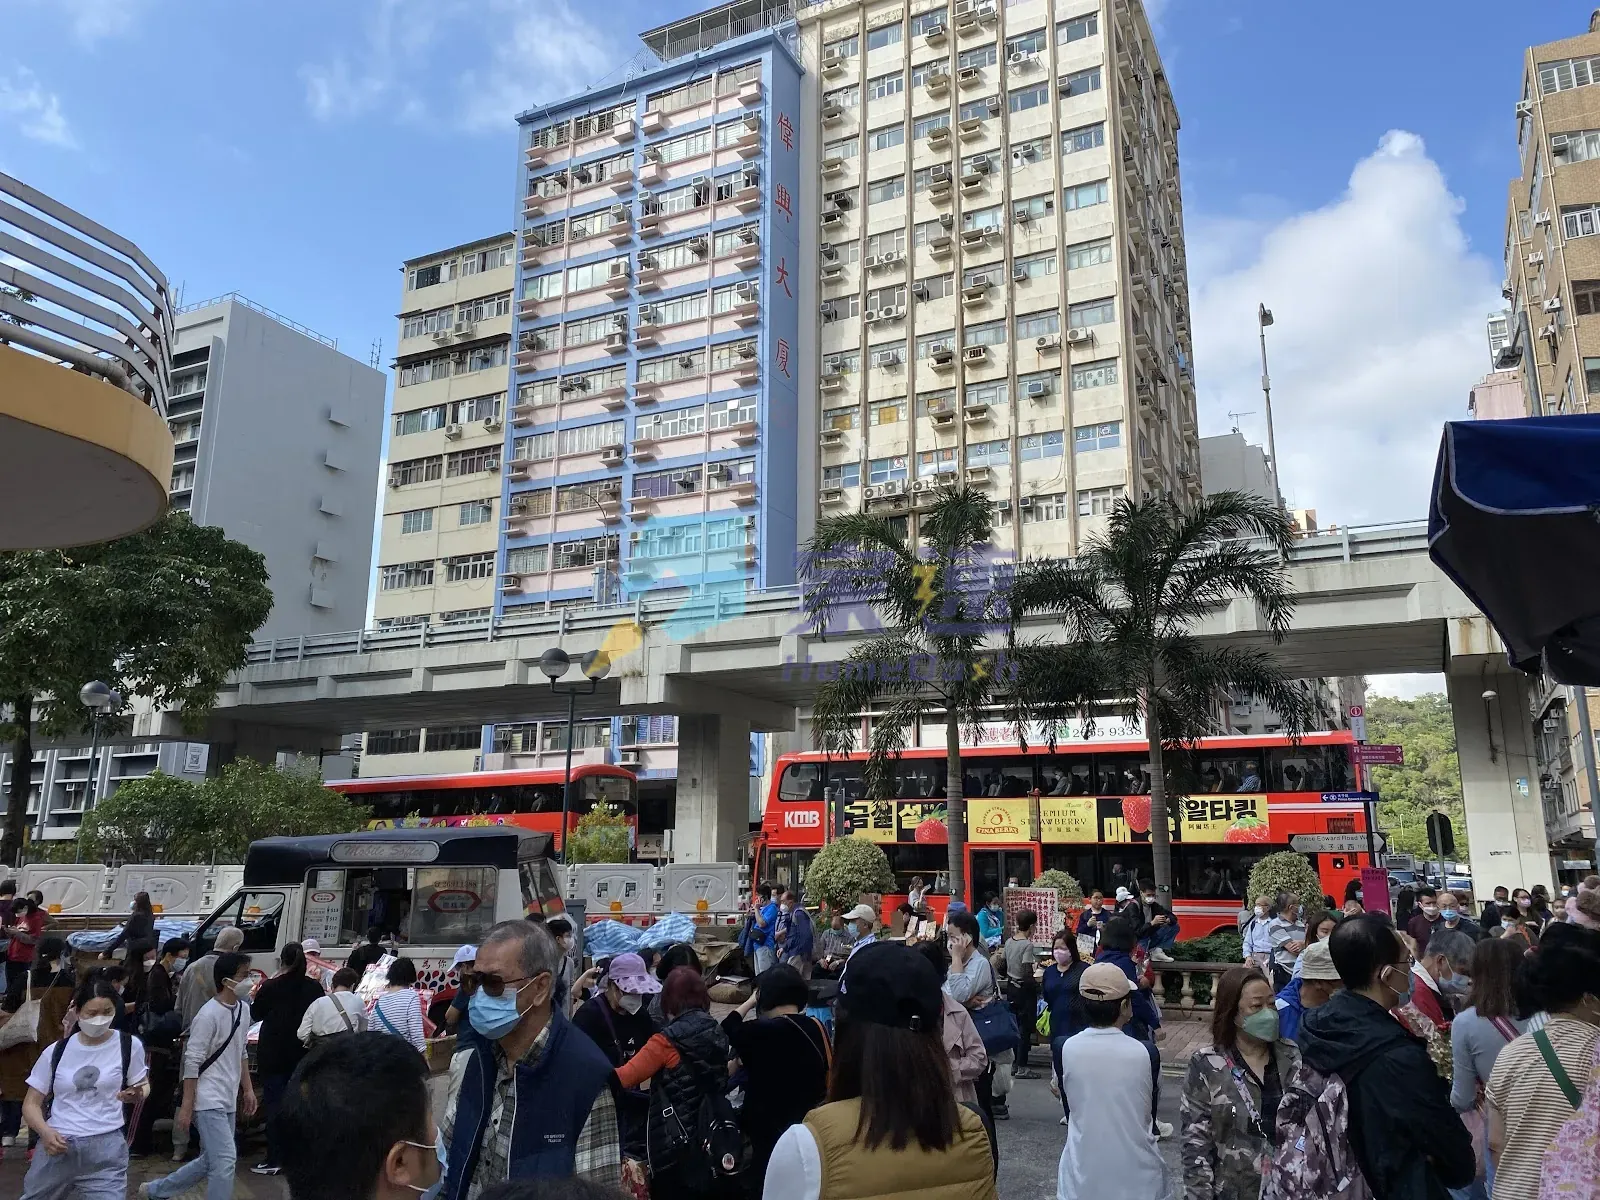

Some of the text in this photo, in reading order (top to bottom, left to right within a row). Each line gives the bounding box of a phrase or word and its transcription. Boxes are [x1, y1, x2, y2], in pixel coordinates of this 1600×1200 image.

[1109, 727, 1142, 737] 9338
[1185, 799, 1257, 822] 알타킹
[784, 810, 820, 828] KMB
[1020, 818, 1087, 826] STAWBERRY
[976, 826, 1019, 834] TINA BERRY
[344, 844, 385, 857] Mobile
[1319, 842, 1355, 851] 太子道西
